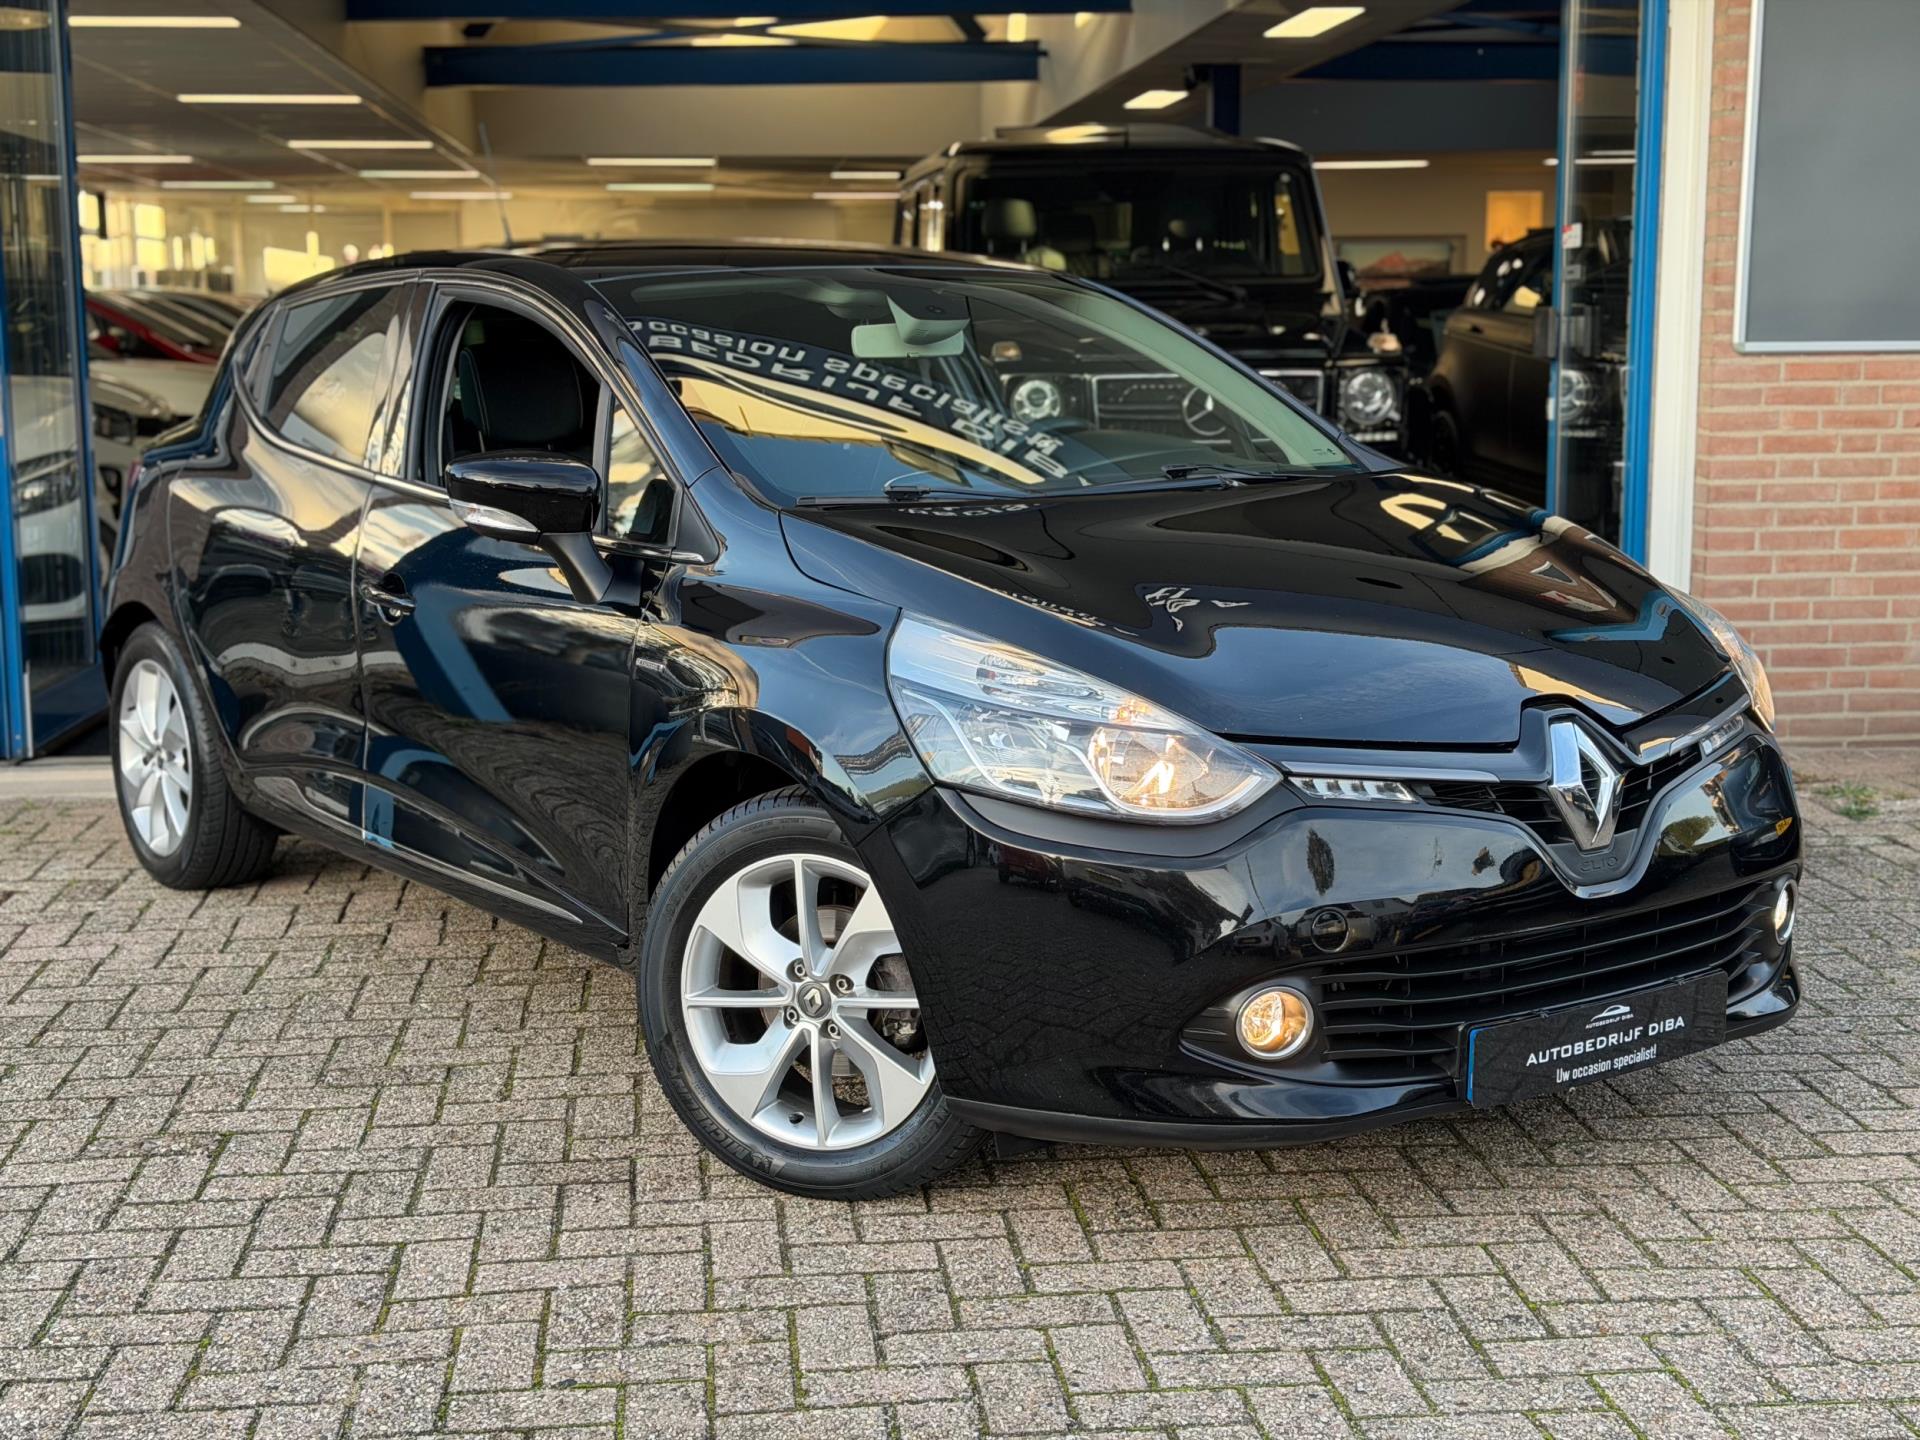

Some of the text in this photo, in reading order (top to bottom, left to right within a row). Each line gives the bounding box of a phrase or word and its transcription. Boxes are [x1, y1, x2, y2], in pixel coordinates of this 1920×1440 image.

[1580, 855, 1618, 872] CLIO
[1585, 1013, 1634, 1030] AUTOBEDRIJF DIBA
[1525, 1016, 1685, 1067] AUTOBEDRIJF DIBA
[1556, 1043, 1657, 1084] Uw occasion specialist!
